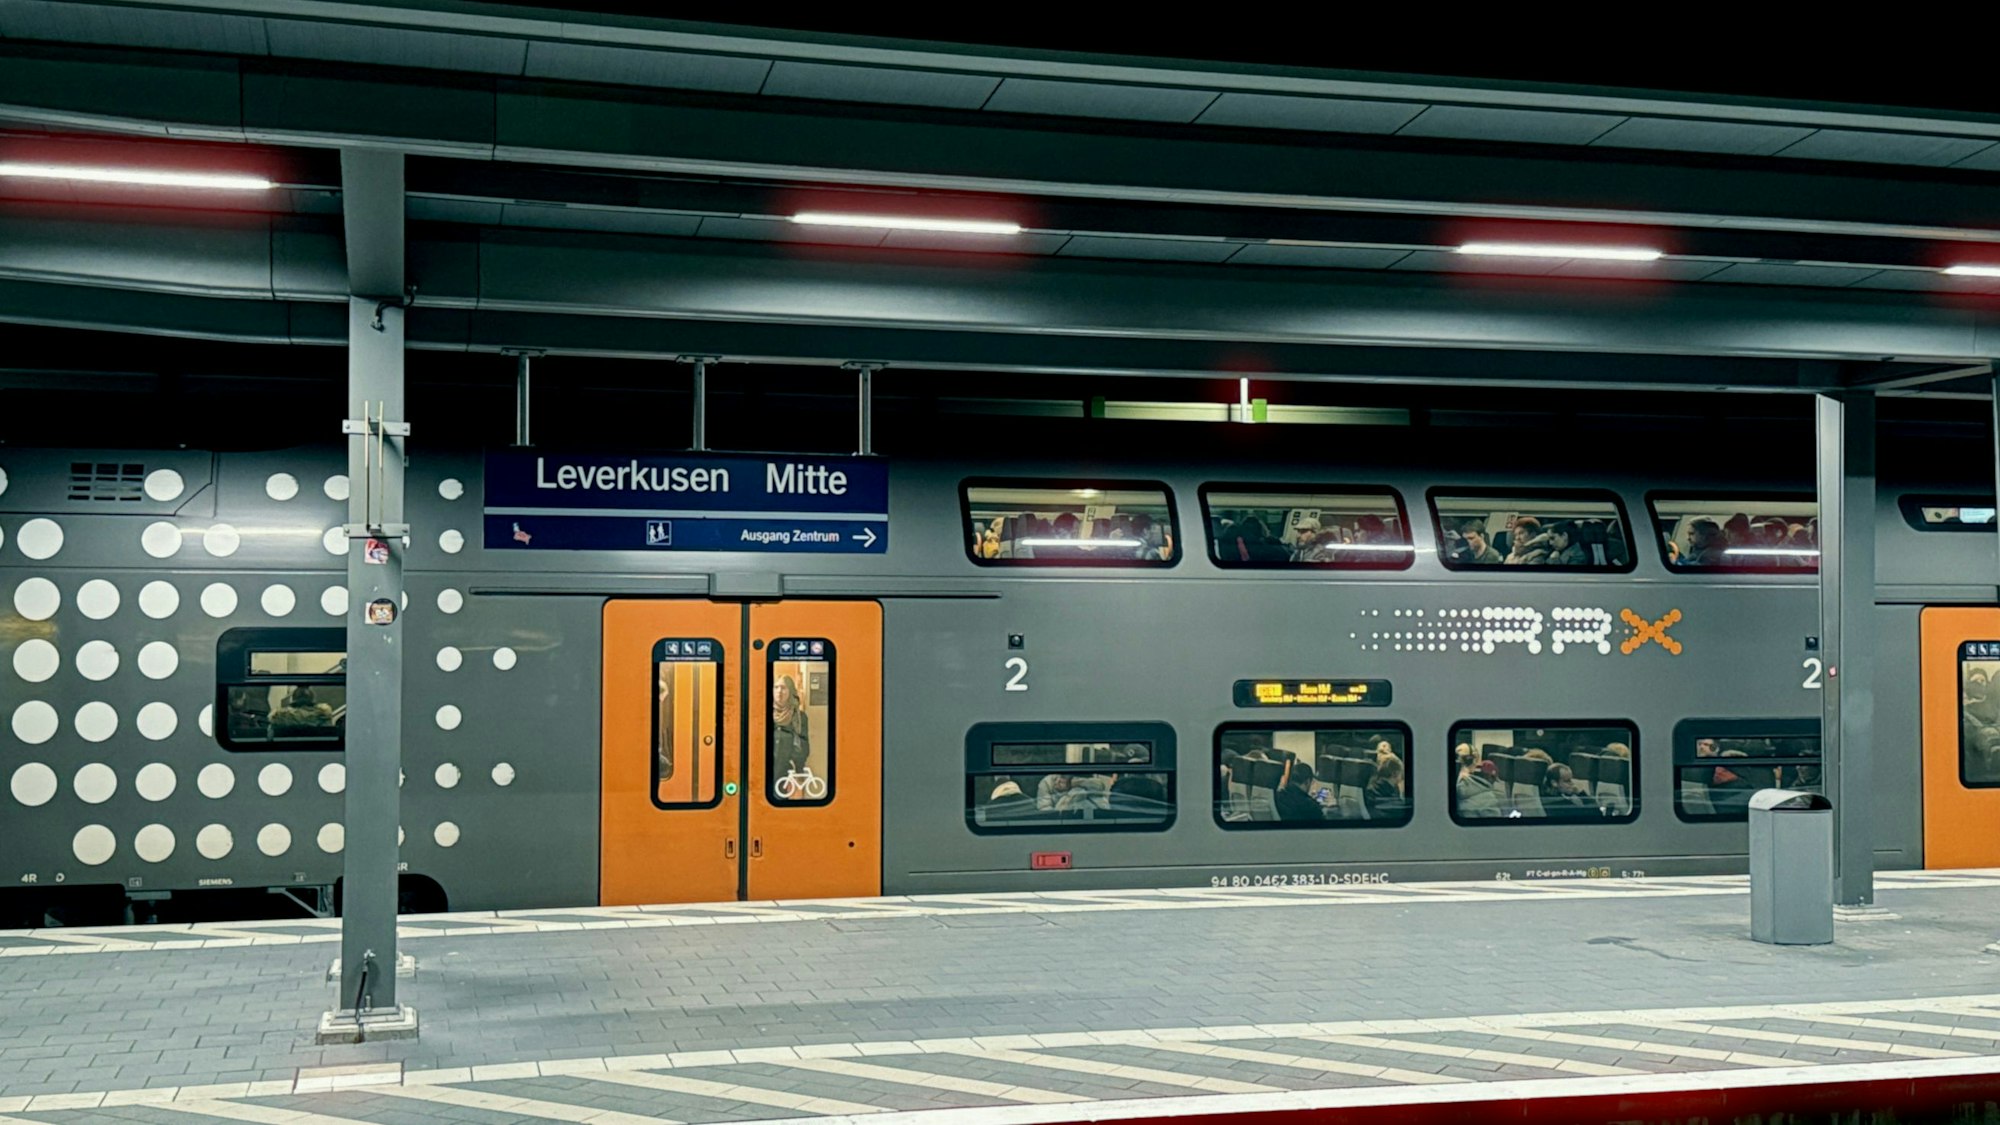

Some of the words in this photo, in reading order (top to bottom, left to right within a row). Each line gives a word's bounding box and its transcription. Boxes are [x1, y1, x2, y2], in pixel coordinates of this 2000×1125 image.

[537, 457, 729, 493] Leverkusen
[766, 463, 848, 495] Mitte
[740, 528, 791, 544] Ausgang
[792, 529, 840, 543] Zentrum
[1005, 657, 1028, 692] 2
[1802, 658, 1821, 689] 2
[20, 873, 38, 883] 4R
[198, 878, 233, 886] SIEMENS
[1211, 876, 1228, 887] 94
[1232, 875, 1250, 887] 80
[1291, 874, 1326, 886] 383-1
